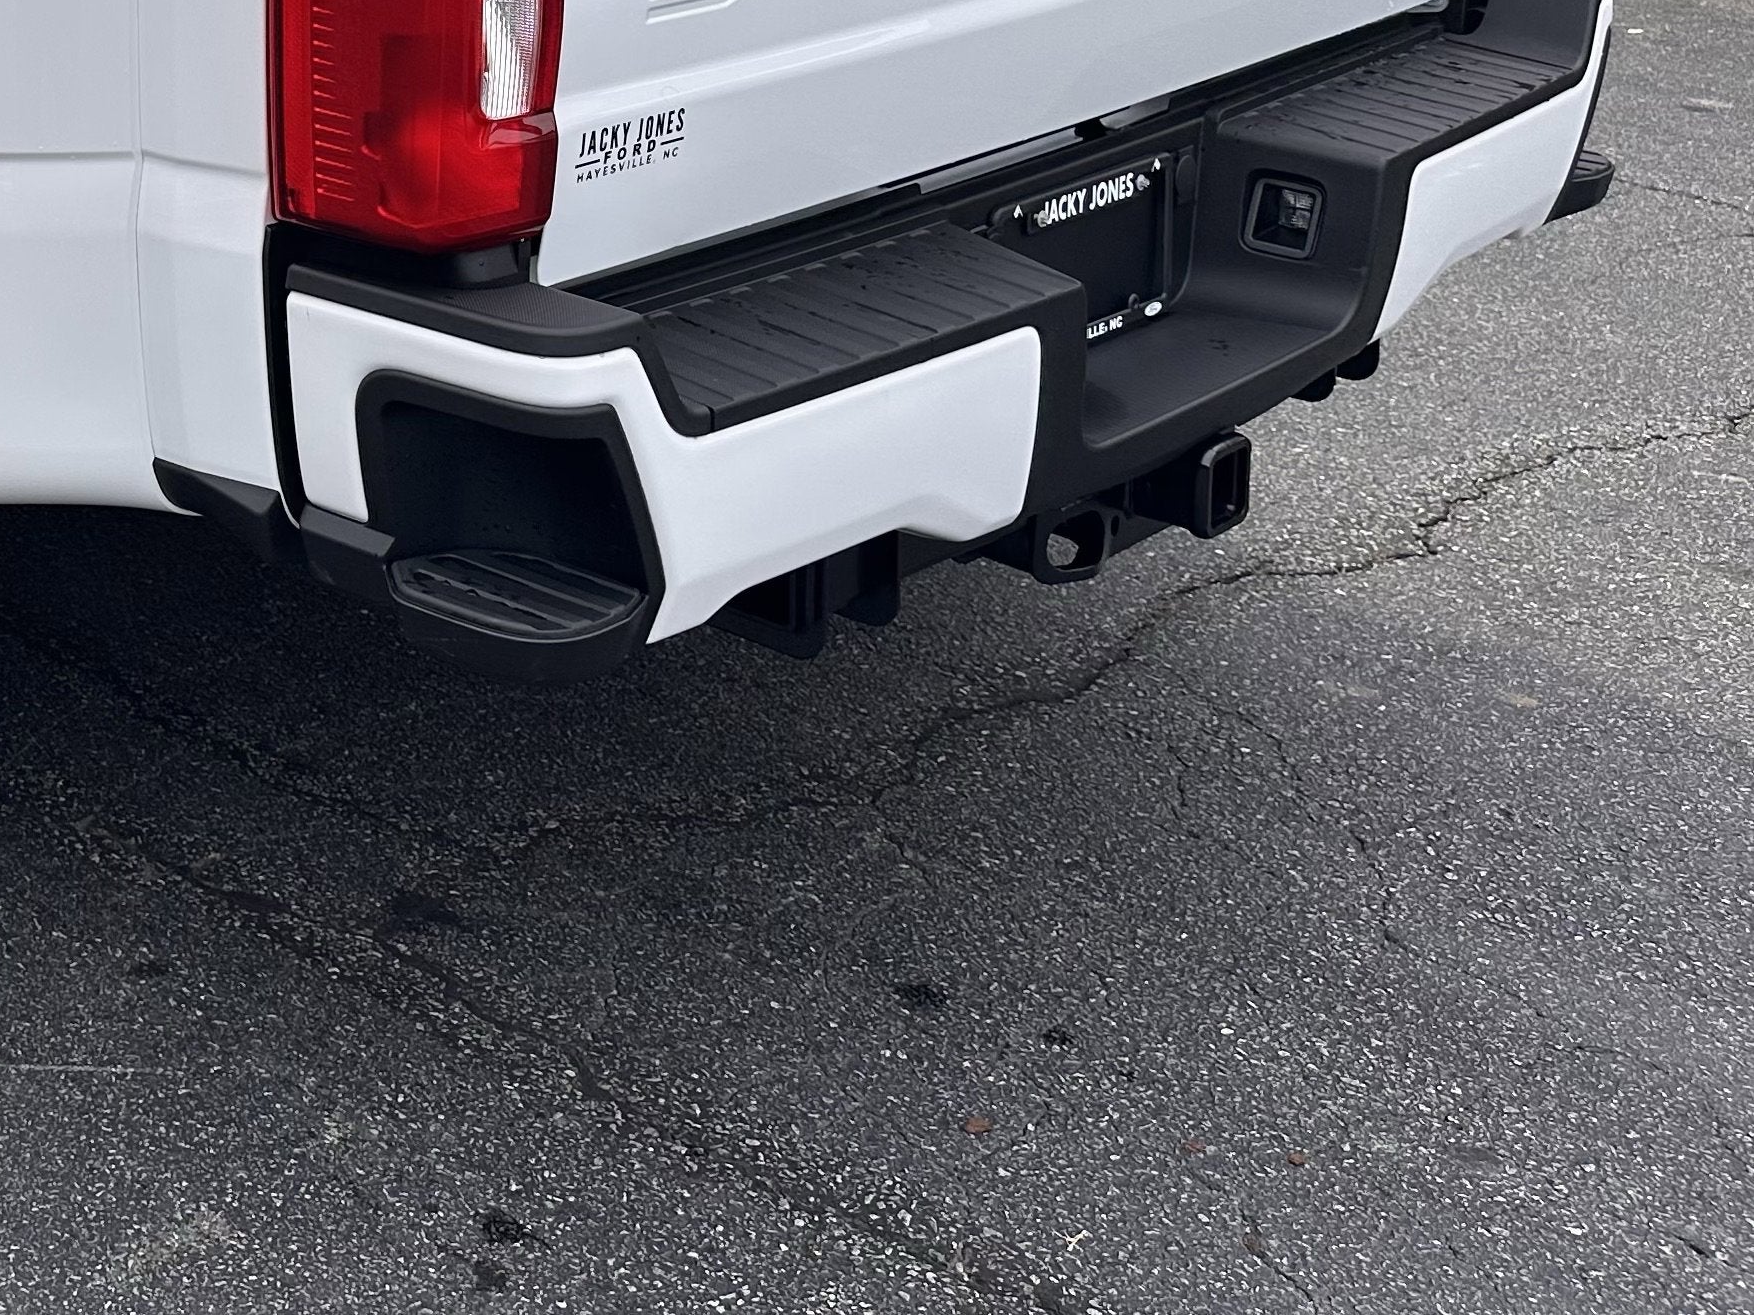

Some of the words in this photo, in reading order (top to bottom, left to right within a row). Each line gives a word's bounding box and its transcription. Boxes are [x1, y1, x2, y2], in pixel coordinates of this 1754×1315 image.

[579, 121, 632, 159] JACKY
[637, 107, 686, 143] JONES
[603, 139, 657, 165] FORD
[663, 146, 679, 160] NC
[1043, 187, 1087, 225] JACKY
[1089, 172, 1135, 211] JONES
